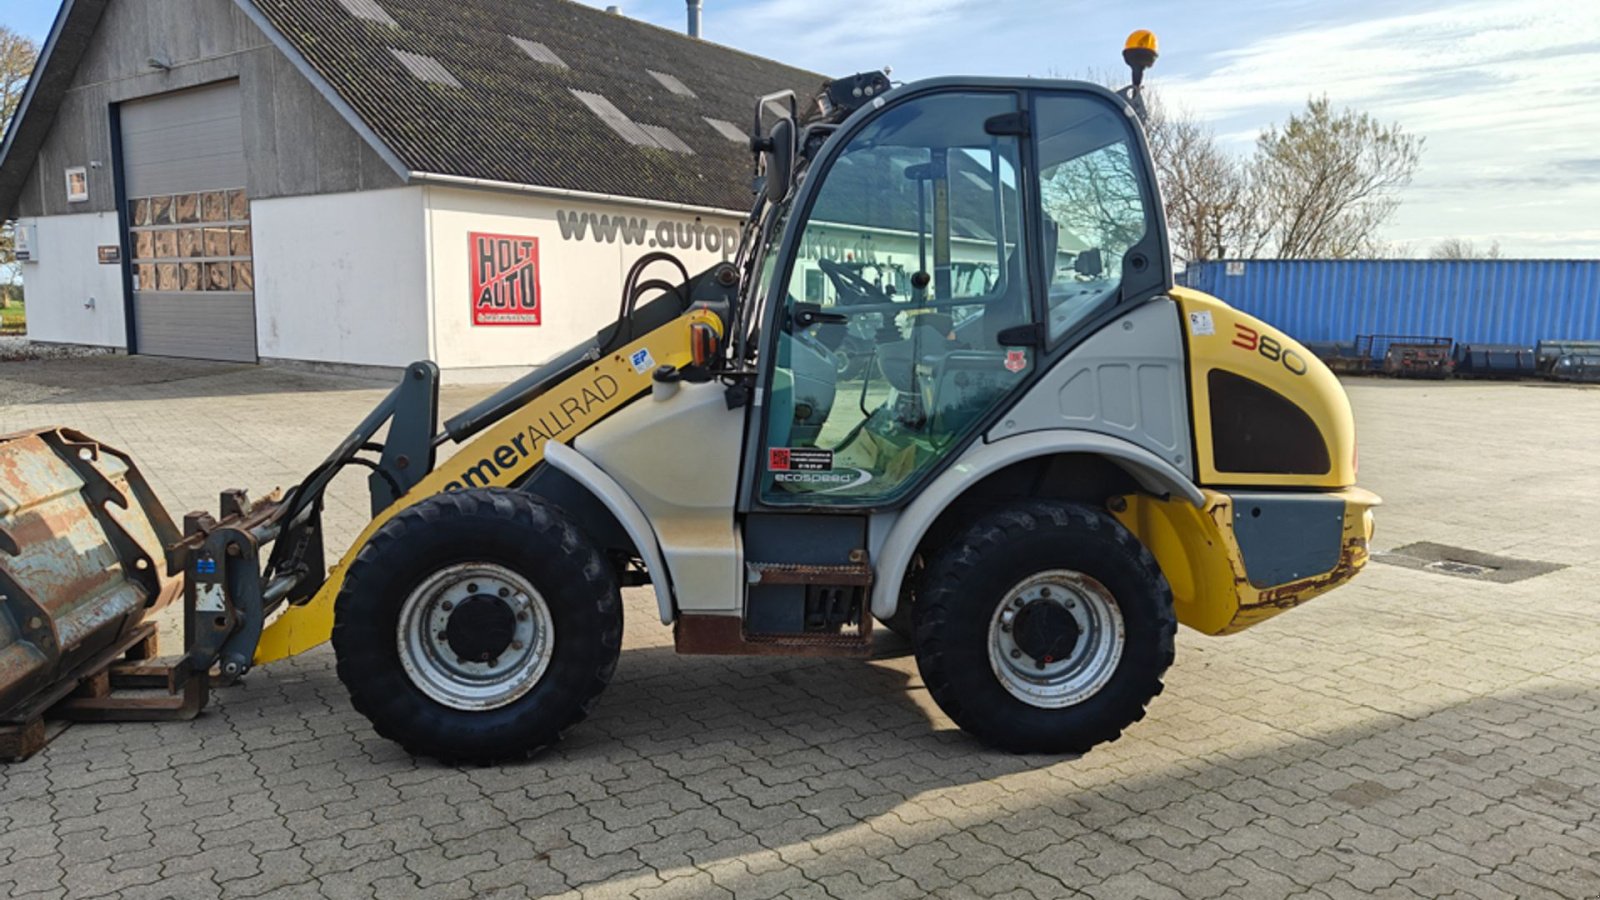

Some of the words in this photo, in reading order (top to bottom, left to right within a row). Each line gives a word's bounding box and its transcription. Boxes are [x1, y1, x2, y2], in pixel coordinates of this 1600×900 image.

[478, 238, 533, 284] HOLT
[478, 262, 536, 308] AUTO
[1232, 323, 1307, 376] 380
[527, 374, 619, 450] ALLRAD
[774, 473, 850, 484] ecospeed
